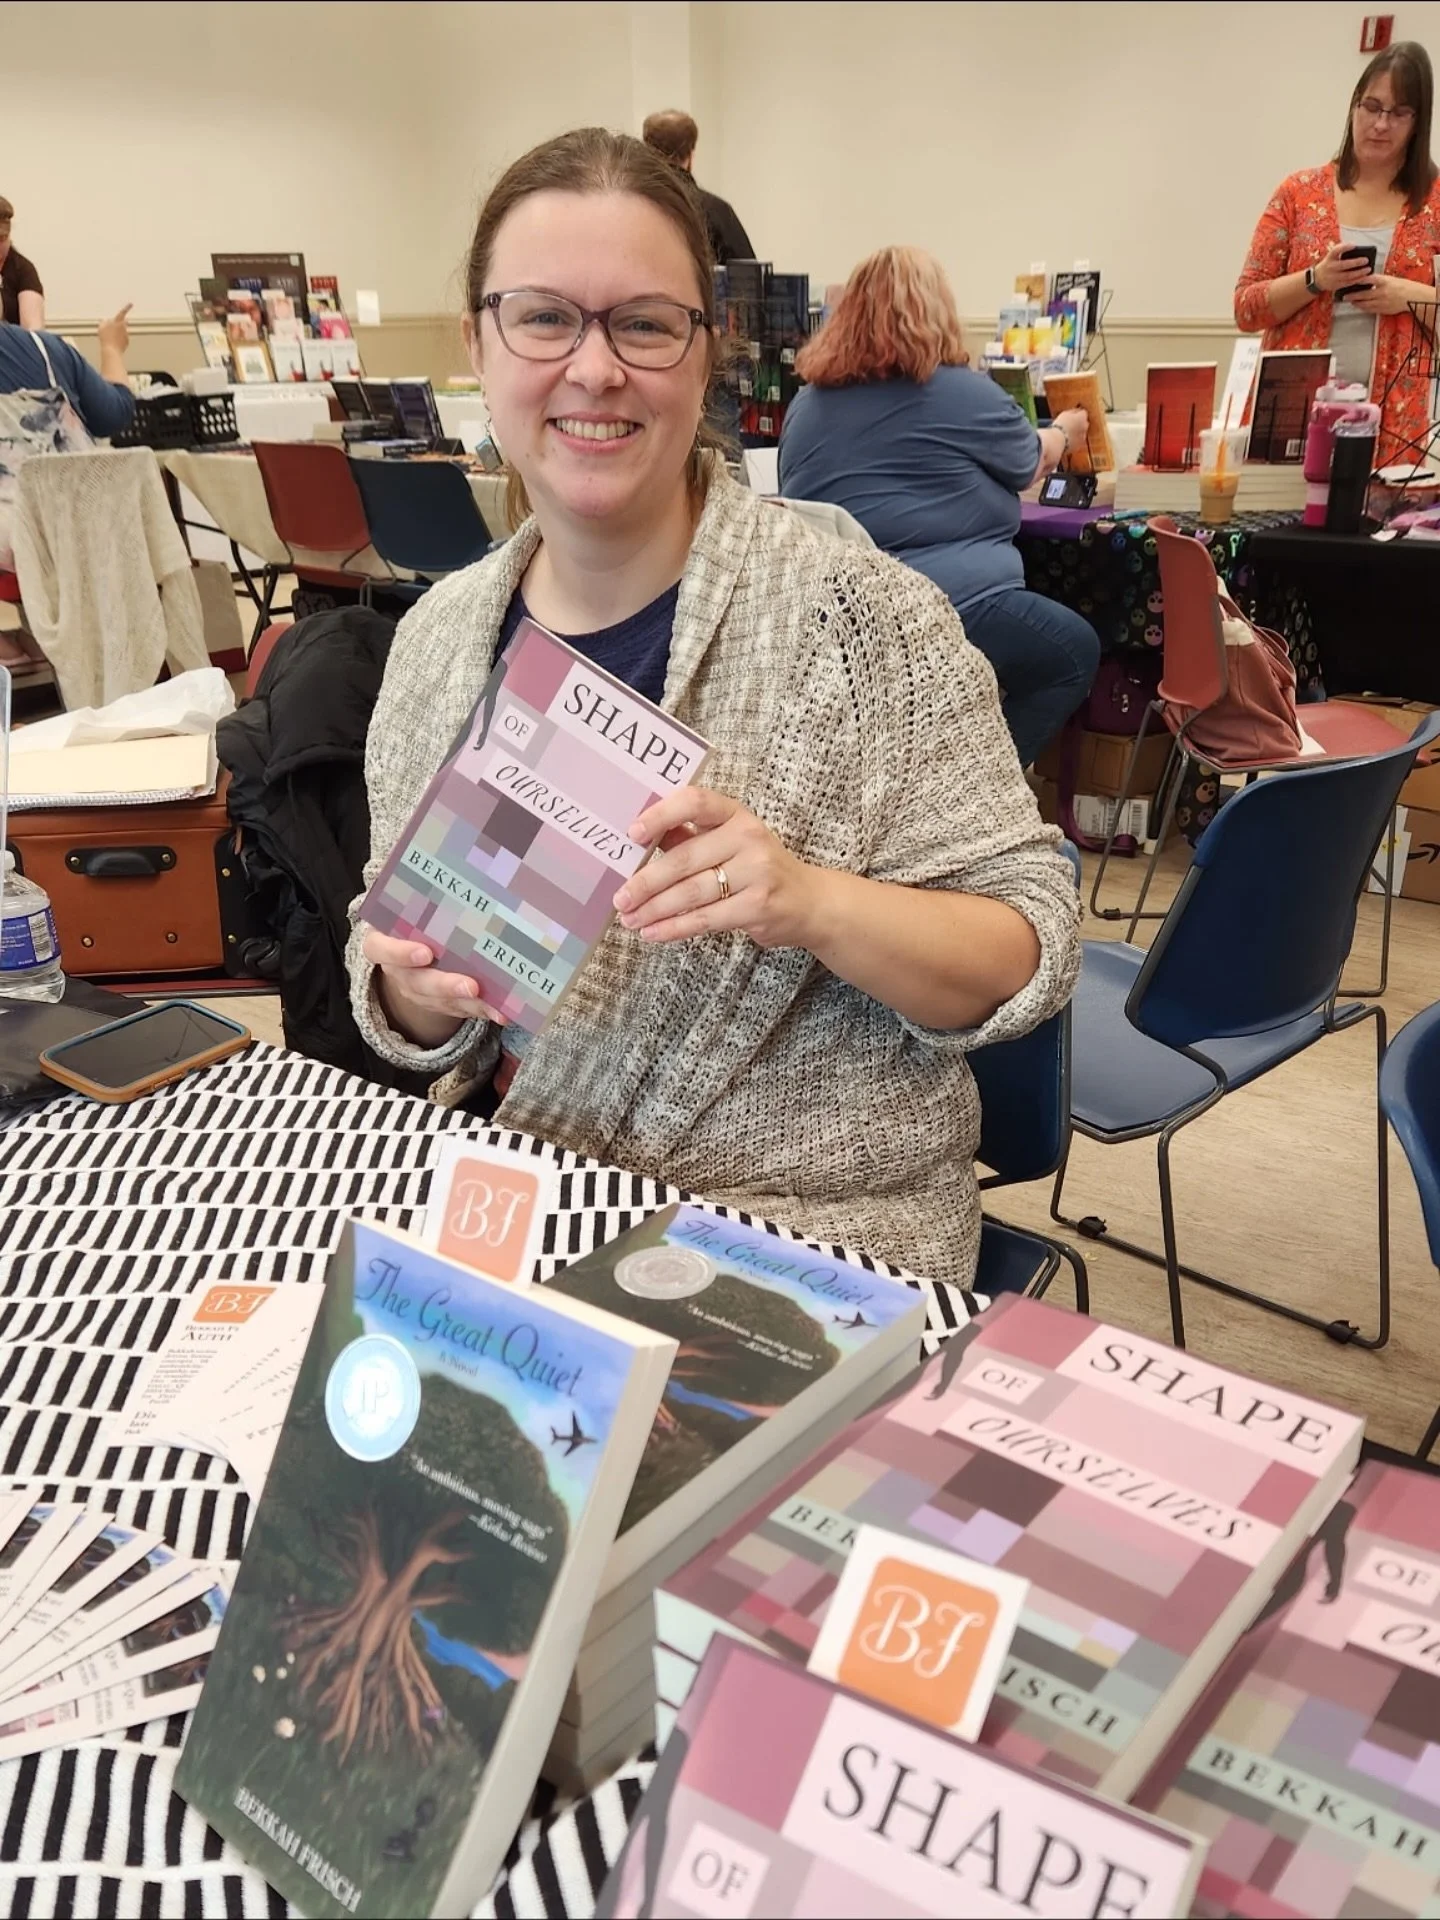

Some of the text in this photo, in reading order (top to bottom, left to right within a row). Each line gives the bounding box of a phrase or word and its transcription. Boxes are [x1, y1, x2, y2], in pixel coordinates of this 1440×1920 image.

[503, 714, 529, 738] OF
[563, 683, 690, 785] SHAPE
[495, 764, 634, 862] OURSELVES
[407, 850, 489, 912] BEKKAH
[481, 938, 556, 995] FRISCH
[674, 1219, 714, 1250] The
[715, 1241, 796, 1277] Great
[799, 1267, 875, 1306] Quiet
[355, 1258, 583, 1397] The Great Quiet
[980, 1367, 1028, 1393] OF
[1090, 1343, 1333, 1456] SHAPE
[967, 1415, 1254, 1542] OURSELVES
[1374, 1559, 1432, 1589] OF
[233, 1786, 362, 1913] BEKKAH FRISCH
[823, 1743, 1150, 1918] SHAPE
[1208, 1746, 1429, 1858] BEKKAH
[691, 1848, 751, 1901] OF
